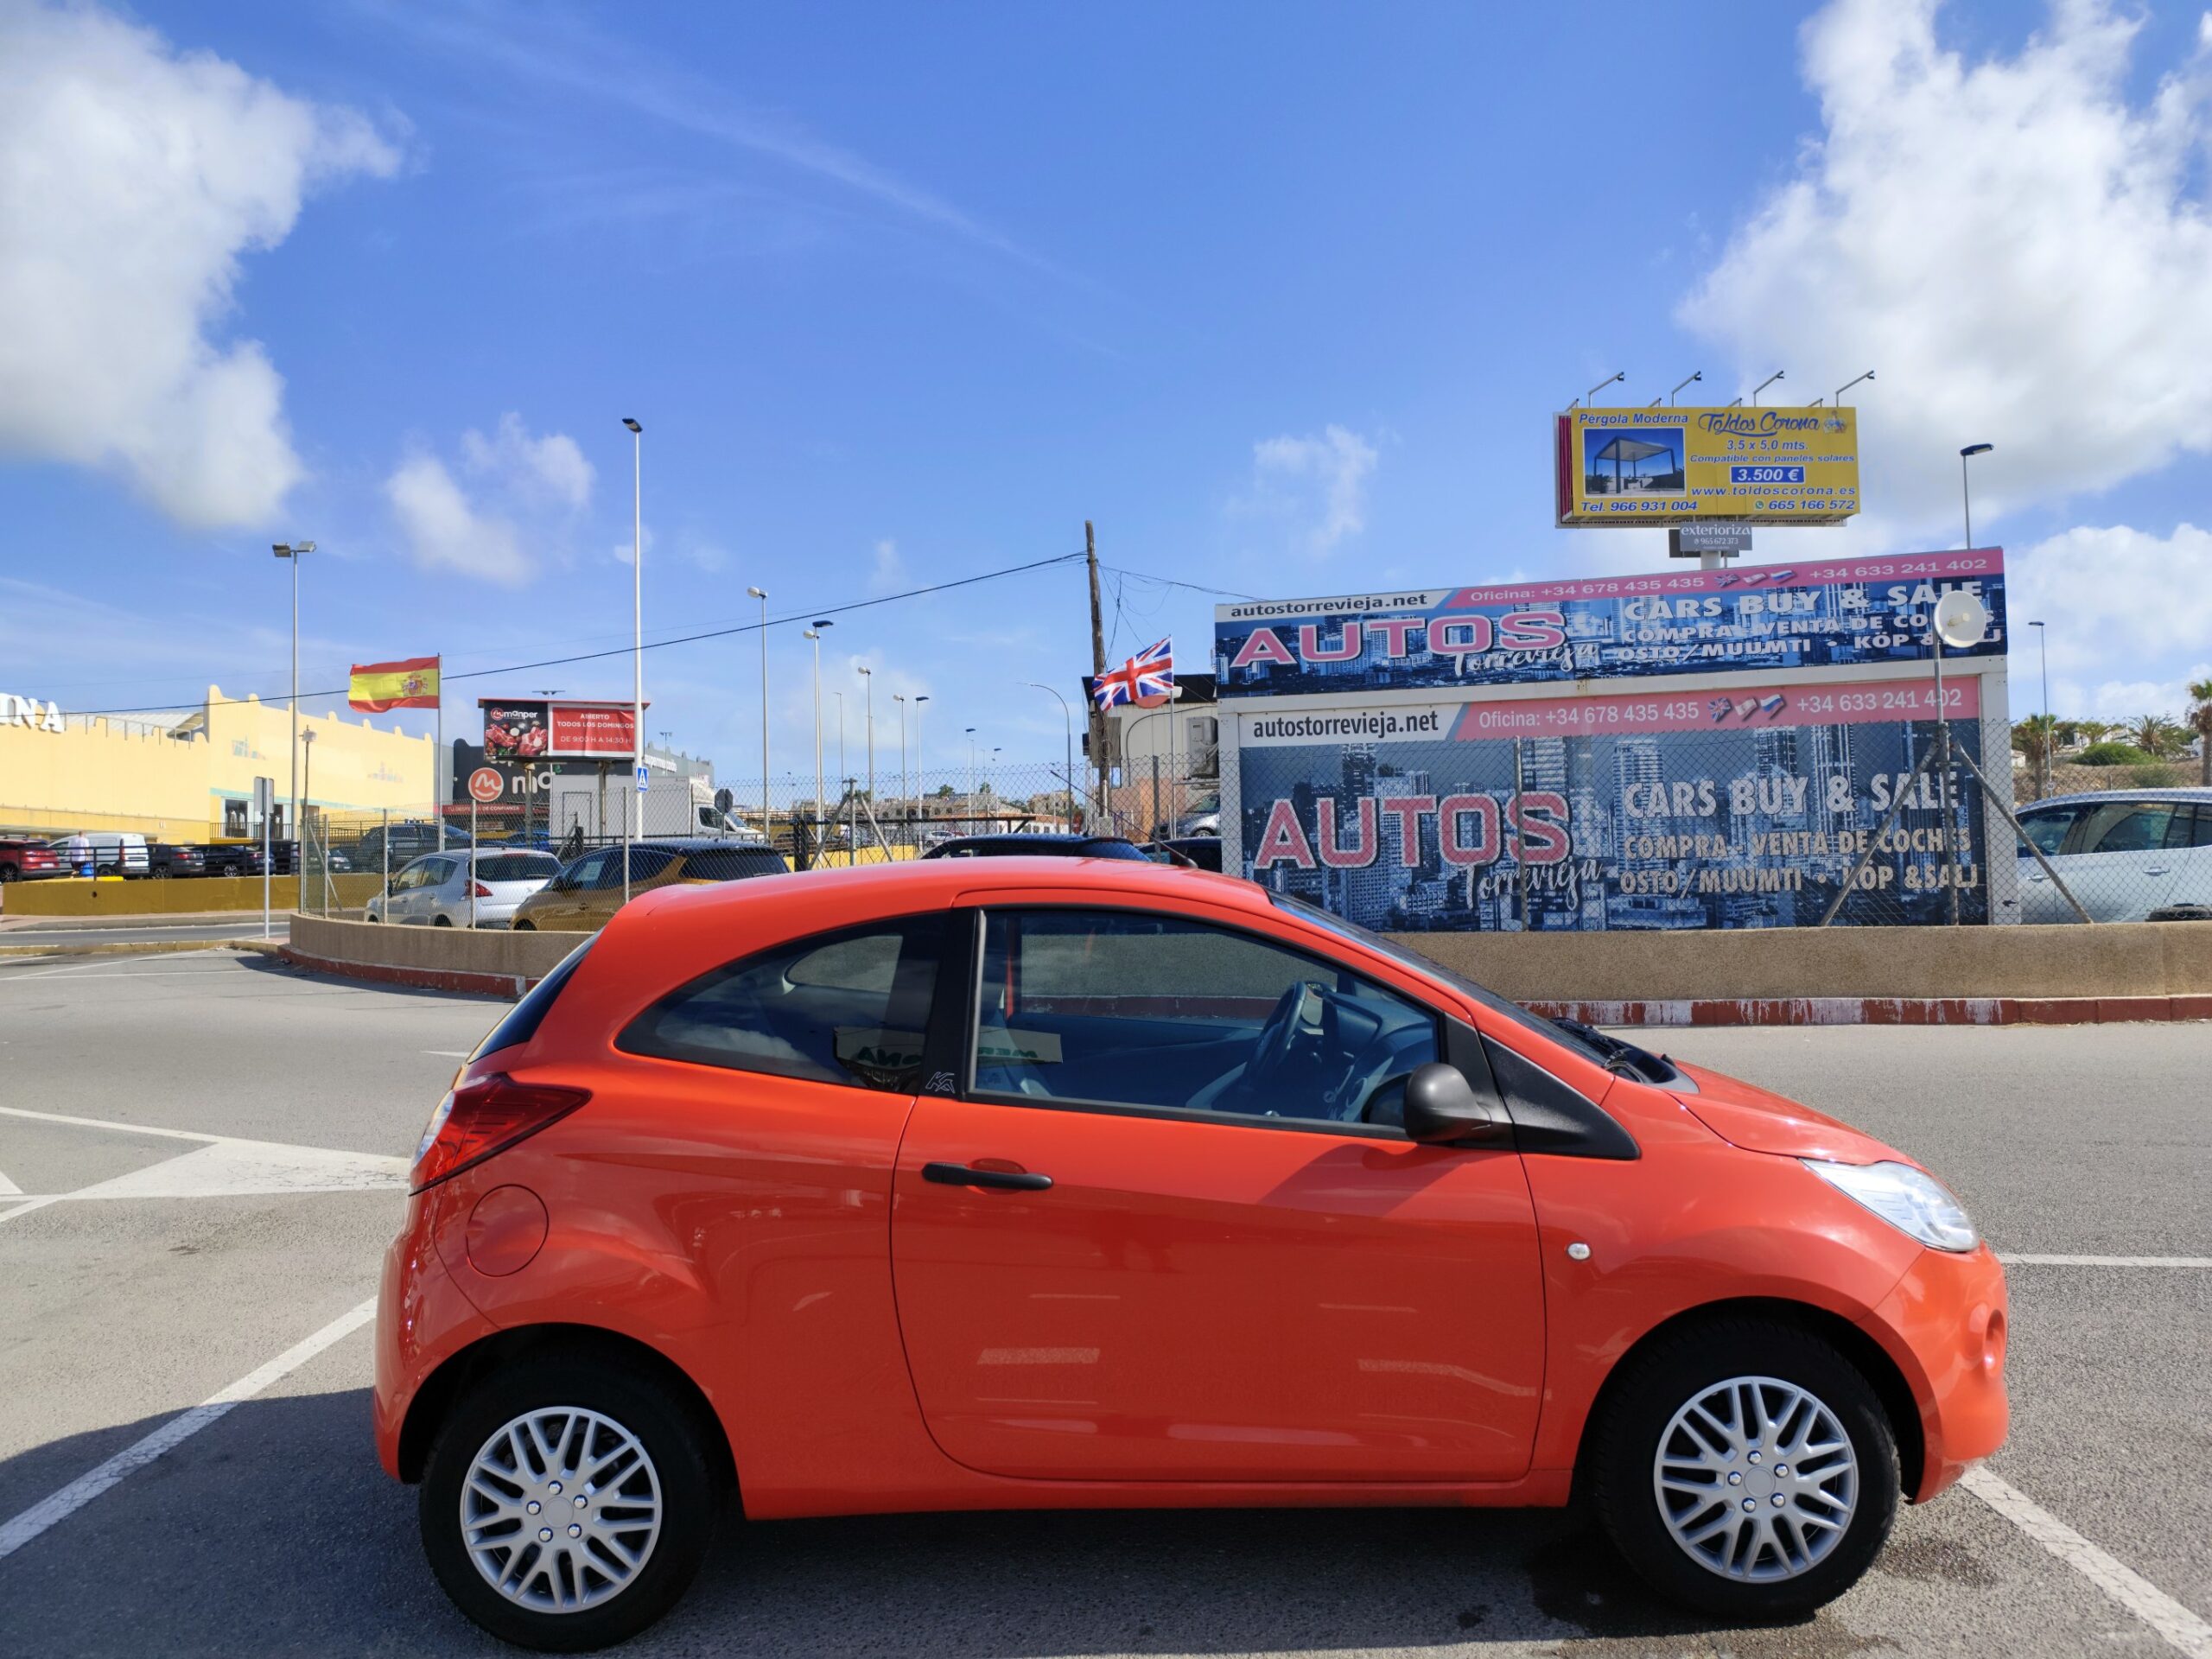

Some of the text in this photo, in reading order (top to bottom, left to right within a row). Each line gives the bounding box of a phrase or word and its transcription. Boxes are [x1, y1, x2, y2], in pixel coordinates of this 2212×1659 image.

[1633, 413, 1688, 423] Moderna
[1698, 411, 1820, 436] Toldos Corona
[1727, 440, 1745, 451] 3,5
[1760, 440, 1778, 451] 5,0
[1782, 441, 1808, 450] mts.
[1690, 454, 1749, 464] Compatible
[1774, 454, 1814, 464] paneles
[1738, 468, 1799, 481] 3.500 €
[1691, 485, 1855, 496] www.toldoscorona.es
[1581, 500, 1698, 512] Tel. 966 931 004
[1769, 499, 1855, 510] 665 166 572
[1681, 524, 1751, 536] exterioriza
[1809, 558, 1986, 580] +34 633 241 402
[1471, 577, 1705, 601] Oficina: +34 678 435 435
[1230, 593, 1427, 617] autostorrevieja.net
[1624, 597, 1722, 620] CARS
[1740, 591, 1821, 614] BUY
[1840, 588, 1870, 609] &
[1230, 611, 1567, 667] AUTOS
[1624, 625, 1732, 643] COMPRA
[1761, 617, 1840, 635] VENTA
[1852, 616, 1884, 630] DE
[1854, 632, 1909, 649] KÖP
[1445, 641, 1599, 677] Torrevieja
[1797, 689, 1962, 713] +34 633 241 402
[504, 709, 538, 721] manper
[1254, 710, 1439, 739] autostorrevieja.net
[1478, 702, 1699, 728] Oficina: +34 678 435 435
[1624, 771, 1959, 819] CARS BUY & SALE
[1253, 791, 1570, 870] AUTOS
[1624, 834, 1728, 860] COMPRA
[1751, 831, 1829, 856] VENTA
[1838, 830, 1868, 855] DE
[1878, 827, 1971, 854] COCHES
[1458, 856, 1603, 911] Torrevieja
